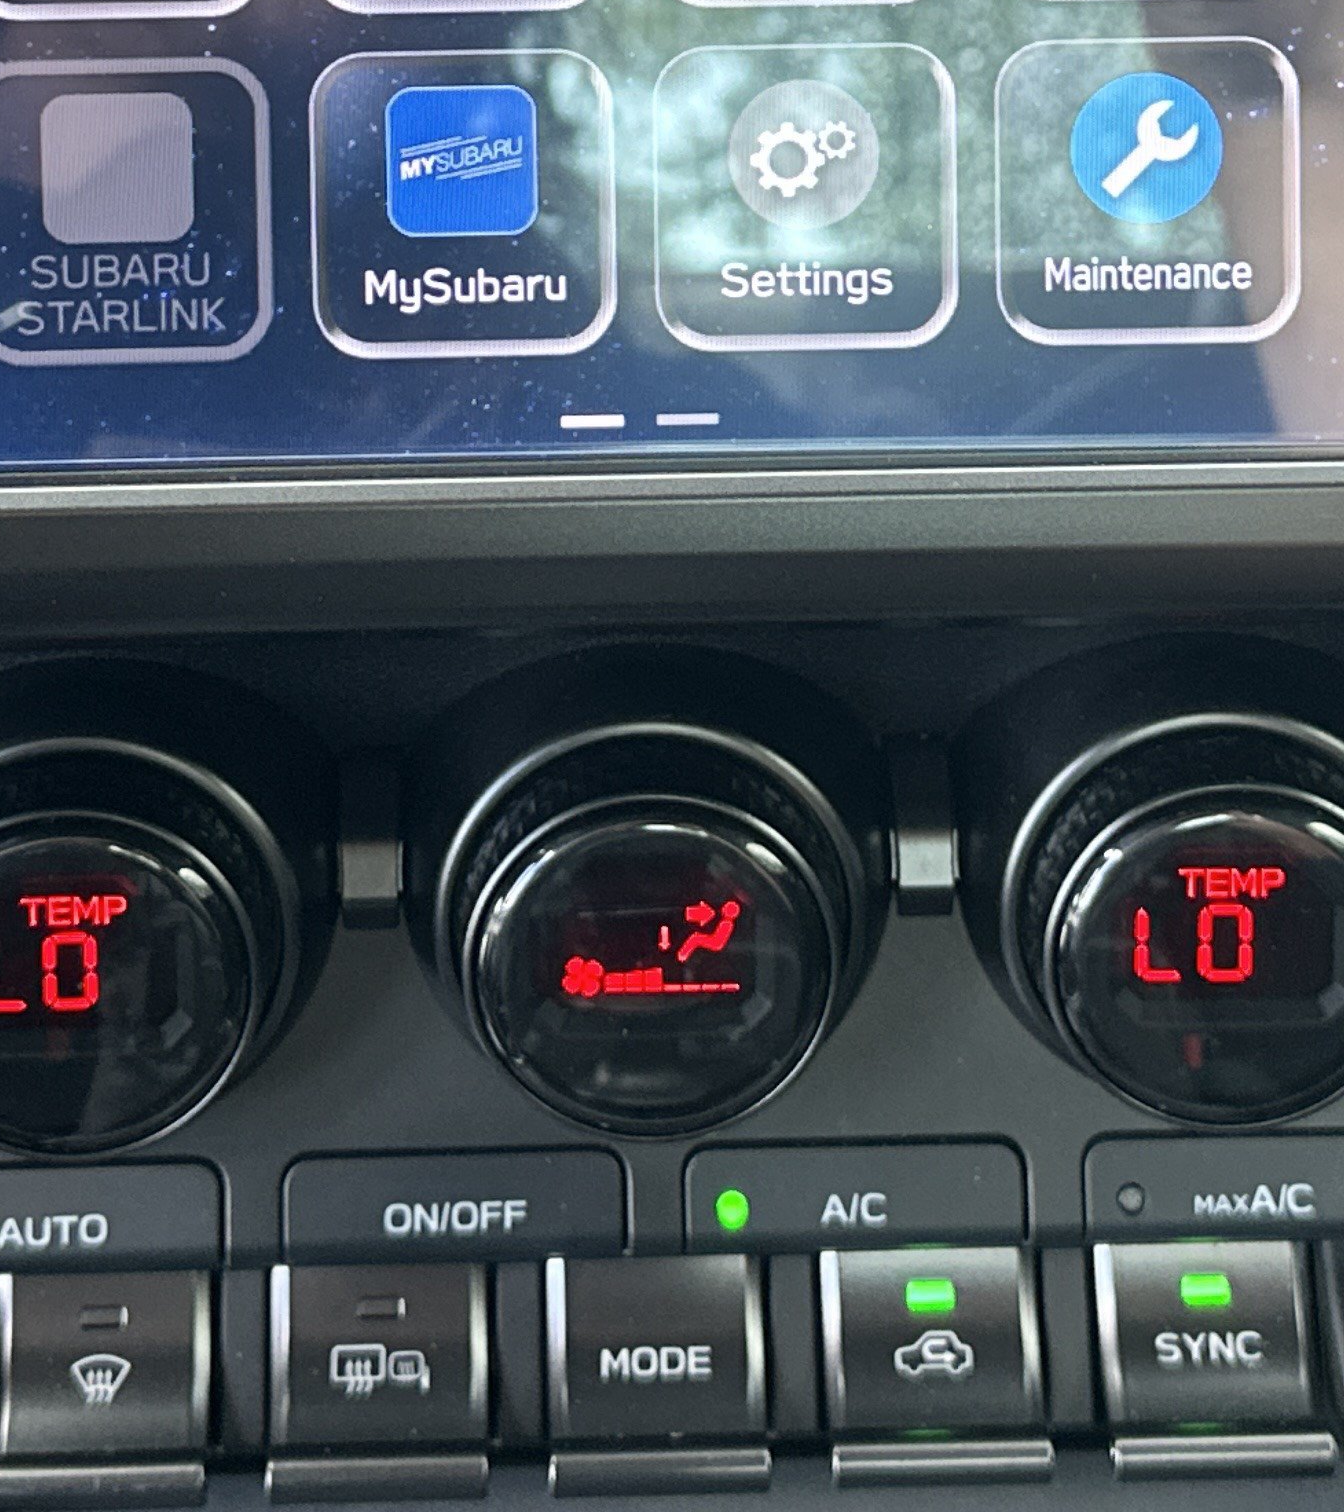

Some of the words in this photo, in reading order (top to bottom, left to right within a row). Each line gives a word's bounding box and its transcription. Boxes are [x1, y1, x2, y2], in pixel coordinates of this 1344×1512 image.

[30, 253, 211, 289] SUBARU
[719, 258, 894, 304] Settings
[1042, 254, 1253, 292] Maintenance
[364, 267, 567, 314] MySubaru
[16, 296, 226, 335] STARLINK
[1178, 867, 1286, 899] TEMP
[19, 895, 127, 926] TEMP
[383, 1200, 527, 1237] ON/OFF
[820, 1192, 887, 1227] A/C
[600, 1345, 713, 1382] MODE
[1155, 1330, 1262, 1369] SYNC
